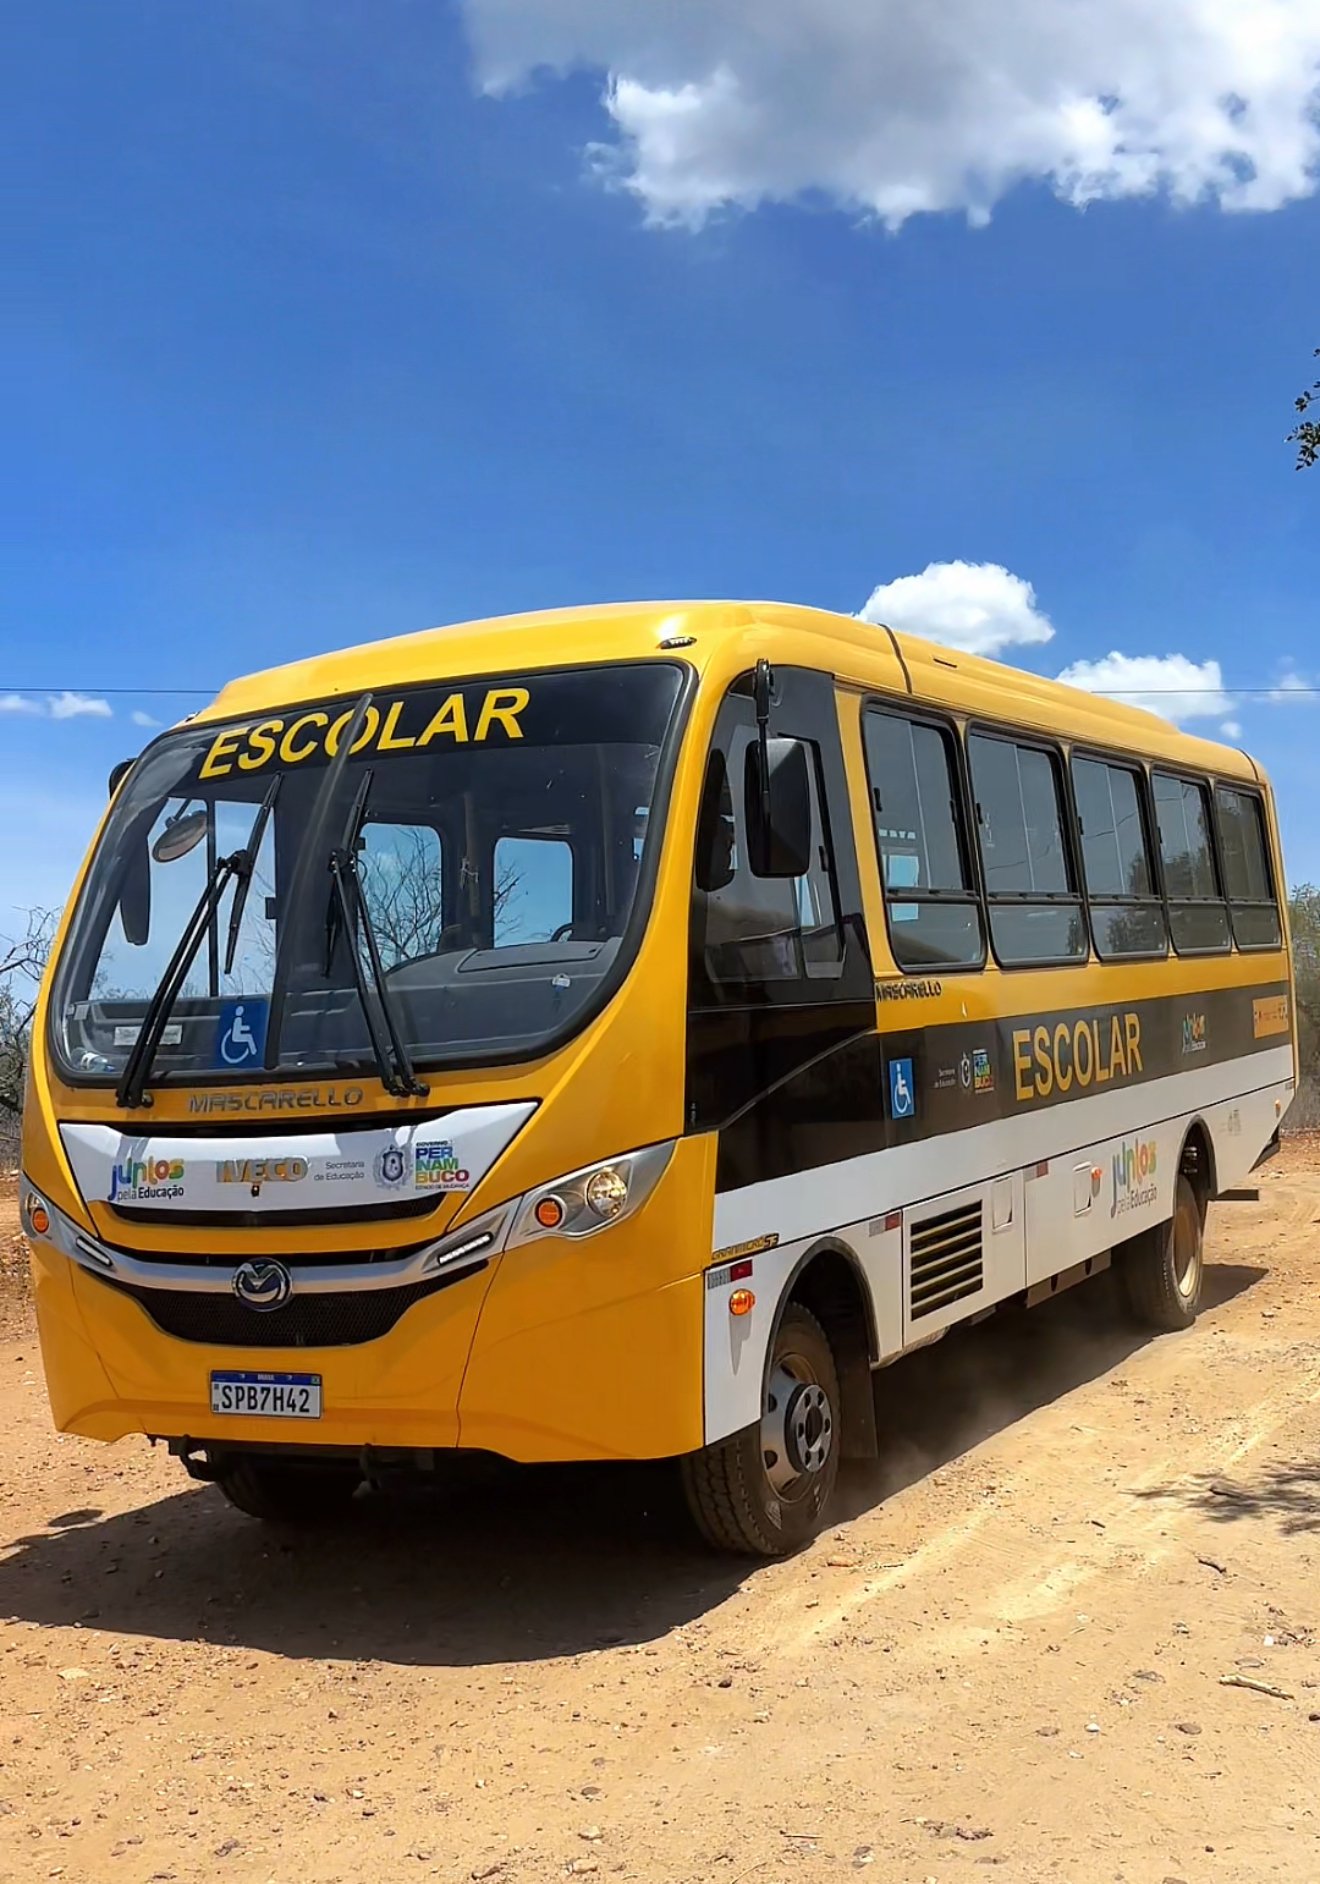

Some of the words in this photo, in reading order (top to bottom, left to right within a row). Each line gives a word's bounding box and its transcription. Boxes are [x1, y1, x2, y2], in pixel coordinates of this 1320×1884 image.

[199, 687, 530, 779] ESCOLAR
[1012, 1012, 1143, 1101] ESCOLAR
[189, 1086, 363, 1113] MASCARELLO
[416, 1147, 453, 1159] PER
[216, 1157, 308, 1182] IVECO
[326, 1160, 365, 1170] Secretaria
[416, 1158, 458, 1171] NAM
[326, 1172, 364, 1182] Educação
[416, 1170, 470, 1184] BUCO
[118, 1188, 137, 1202] pela
[138, 1184, 184, 1199] Educação
[221, 1385, 310, 1413] SPB7H42
